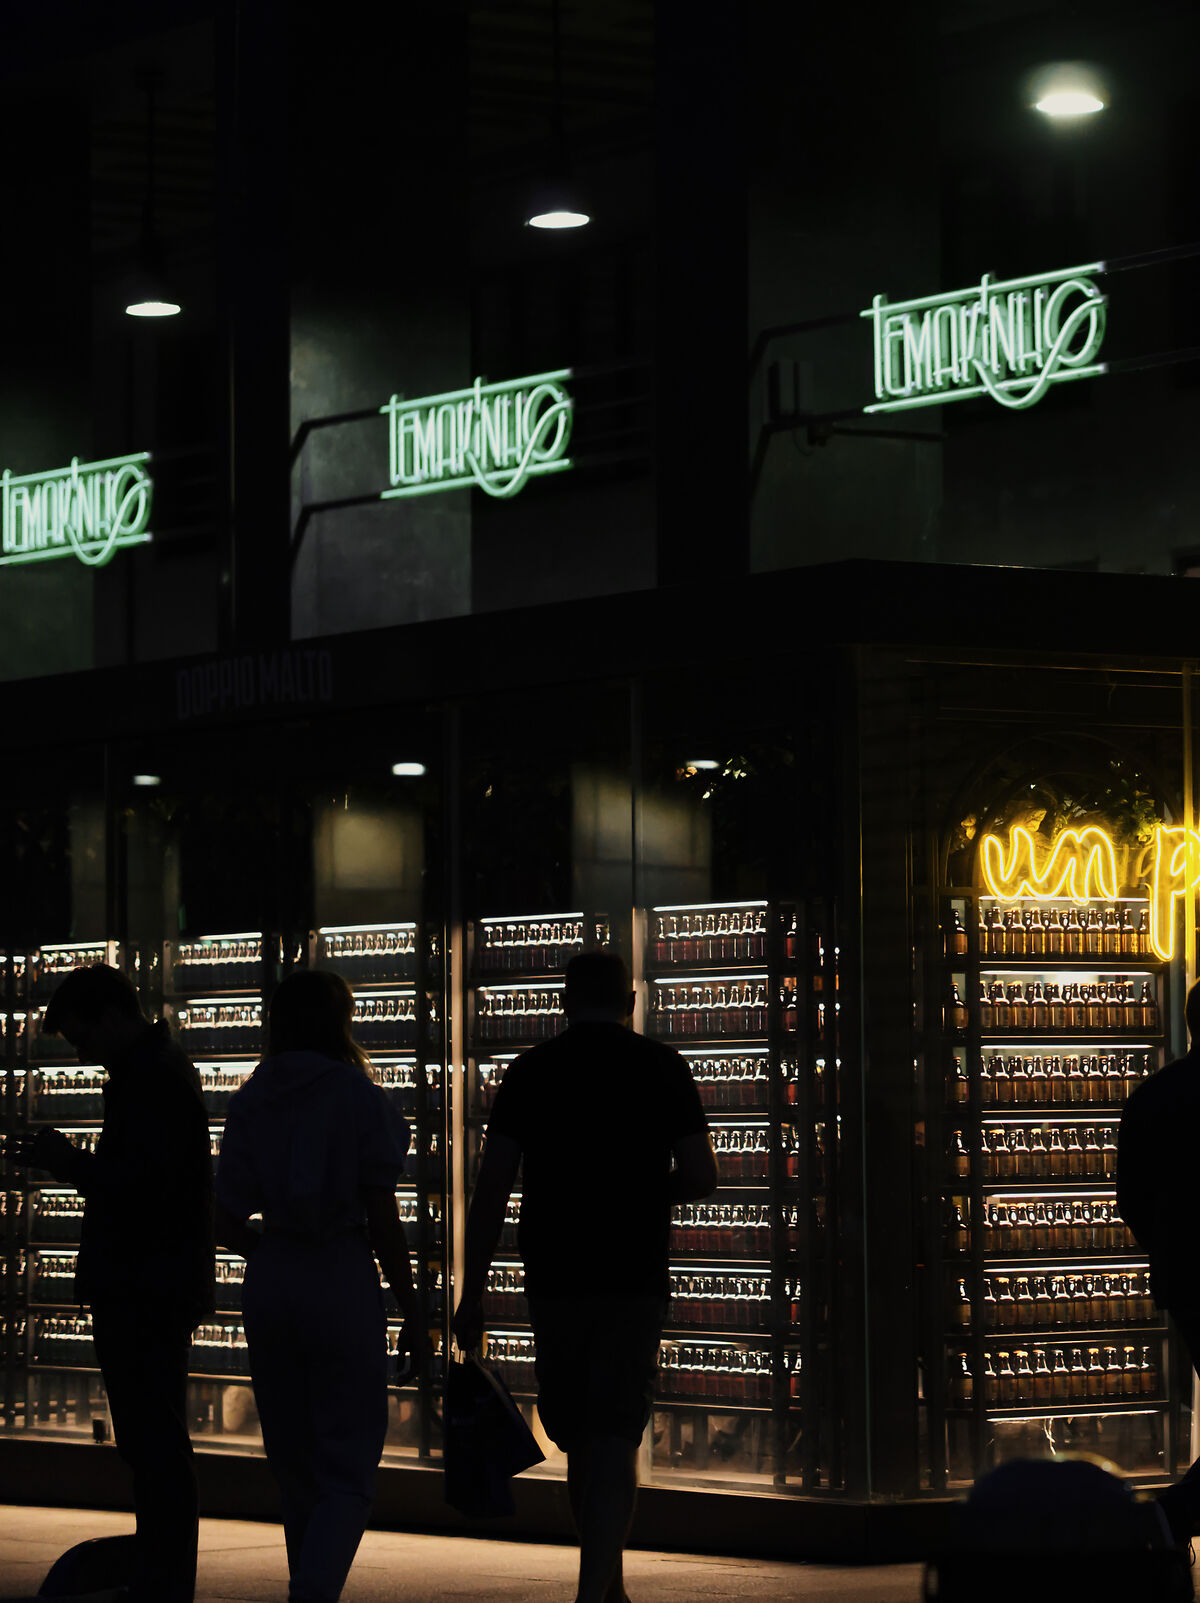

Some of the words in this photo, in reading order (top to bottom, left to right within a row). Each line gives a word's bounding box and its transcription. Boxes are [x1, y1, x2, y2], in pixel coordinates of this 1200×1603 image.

[176, 655, 256, 721] DOPPIO
[258, 650, 334, 705] MALTO
[980, 824, 1118, 904] un
